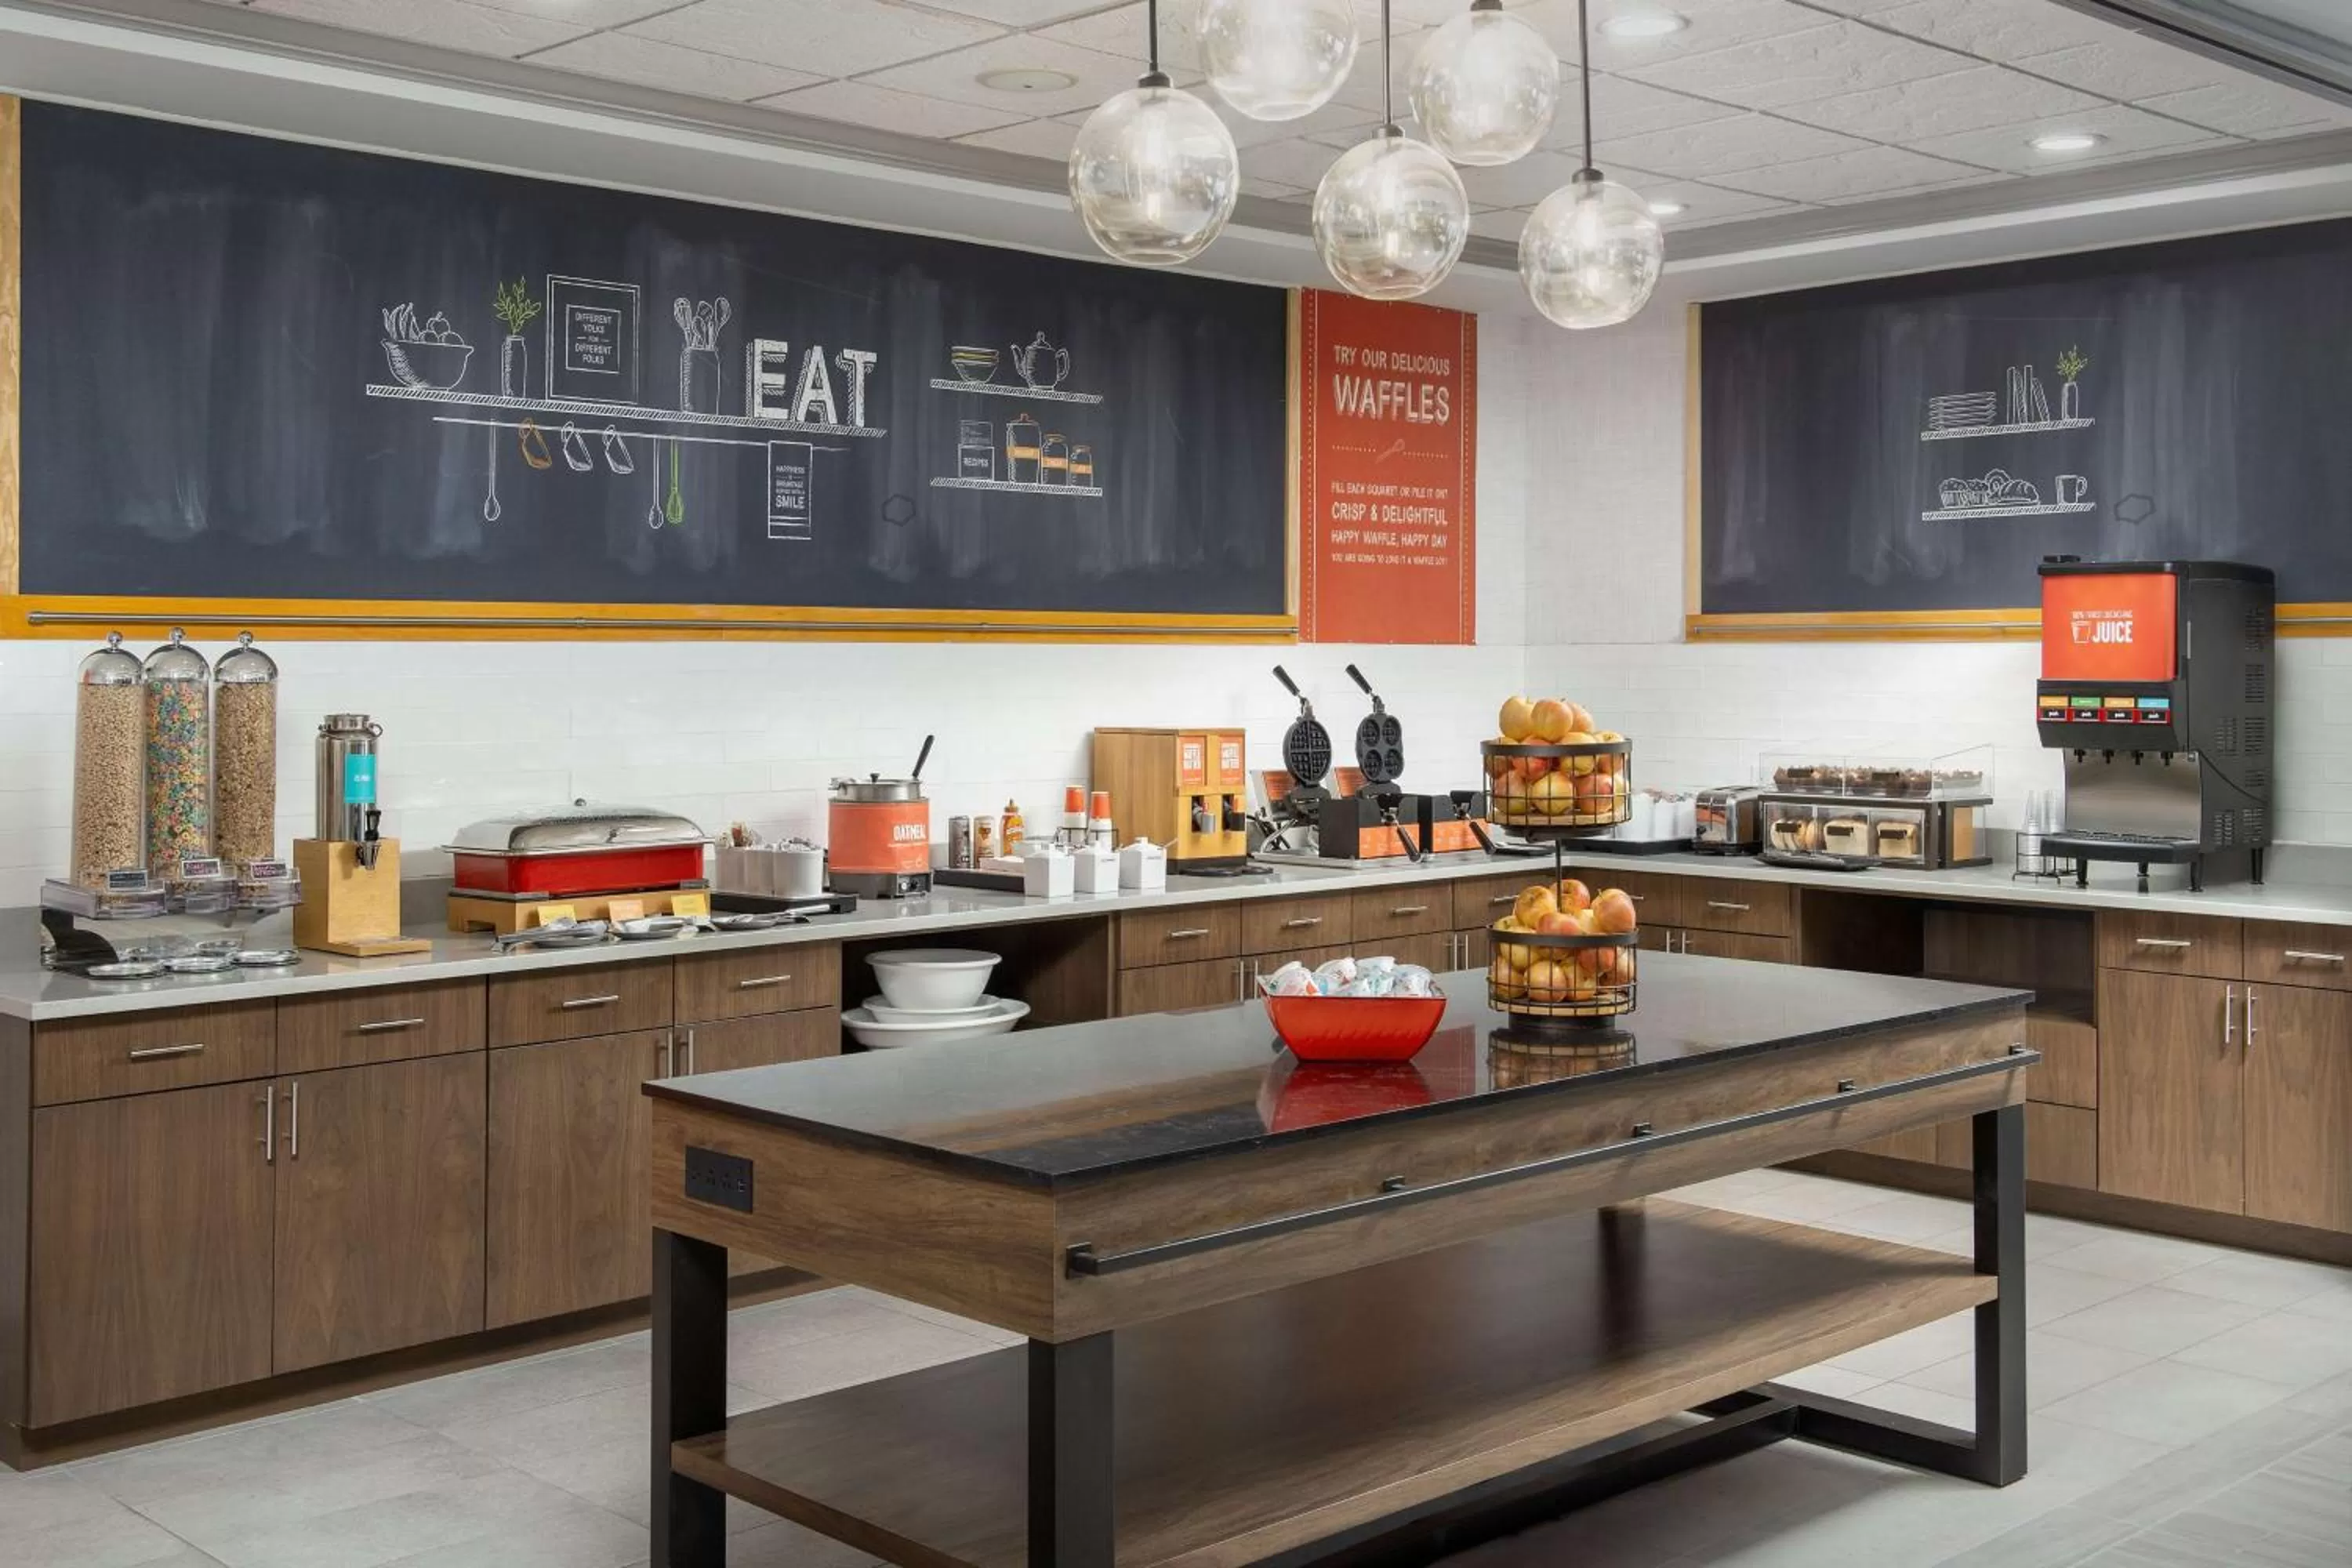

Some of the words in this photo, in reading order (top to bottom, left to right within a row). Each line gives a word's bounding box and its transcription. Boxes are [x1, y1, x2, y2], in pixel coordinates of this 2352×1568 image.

[575, 312, 612, 324] DIFFERENT
[583, 323, 604, 333] YOLKS
[575, 343, 612, 354] DIFFERENT
[583, 354, 604, 365] FOLKS
[1334, 345, 1356, 365] TRY
[1362, 349, 1387, 369] OUR
[1392, 352, 1450, 376] DELICIOUS
[746, 338, 877, 427] EAT
[1334, 374, 1450, 426] WAFFLES
[775, 495, 805, 509] SMILE
[1331, 501, 1367, 521] CRISP
[1370, 503, 1377, 521] &
[1382, 505, 1448, 526] DELIGHTFUL
[1331, 529, 1359, 545] HAPPY
[1401, 532, 1429, 547] HAPPY
[1432, 533, 1448, 548] DAY
[2092, 620, 2133, 644] JUICE
[893, 824, 926, 841] OATMEAL
